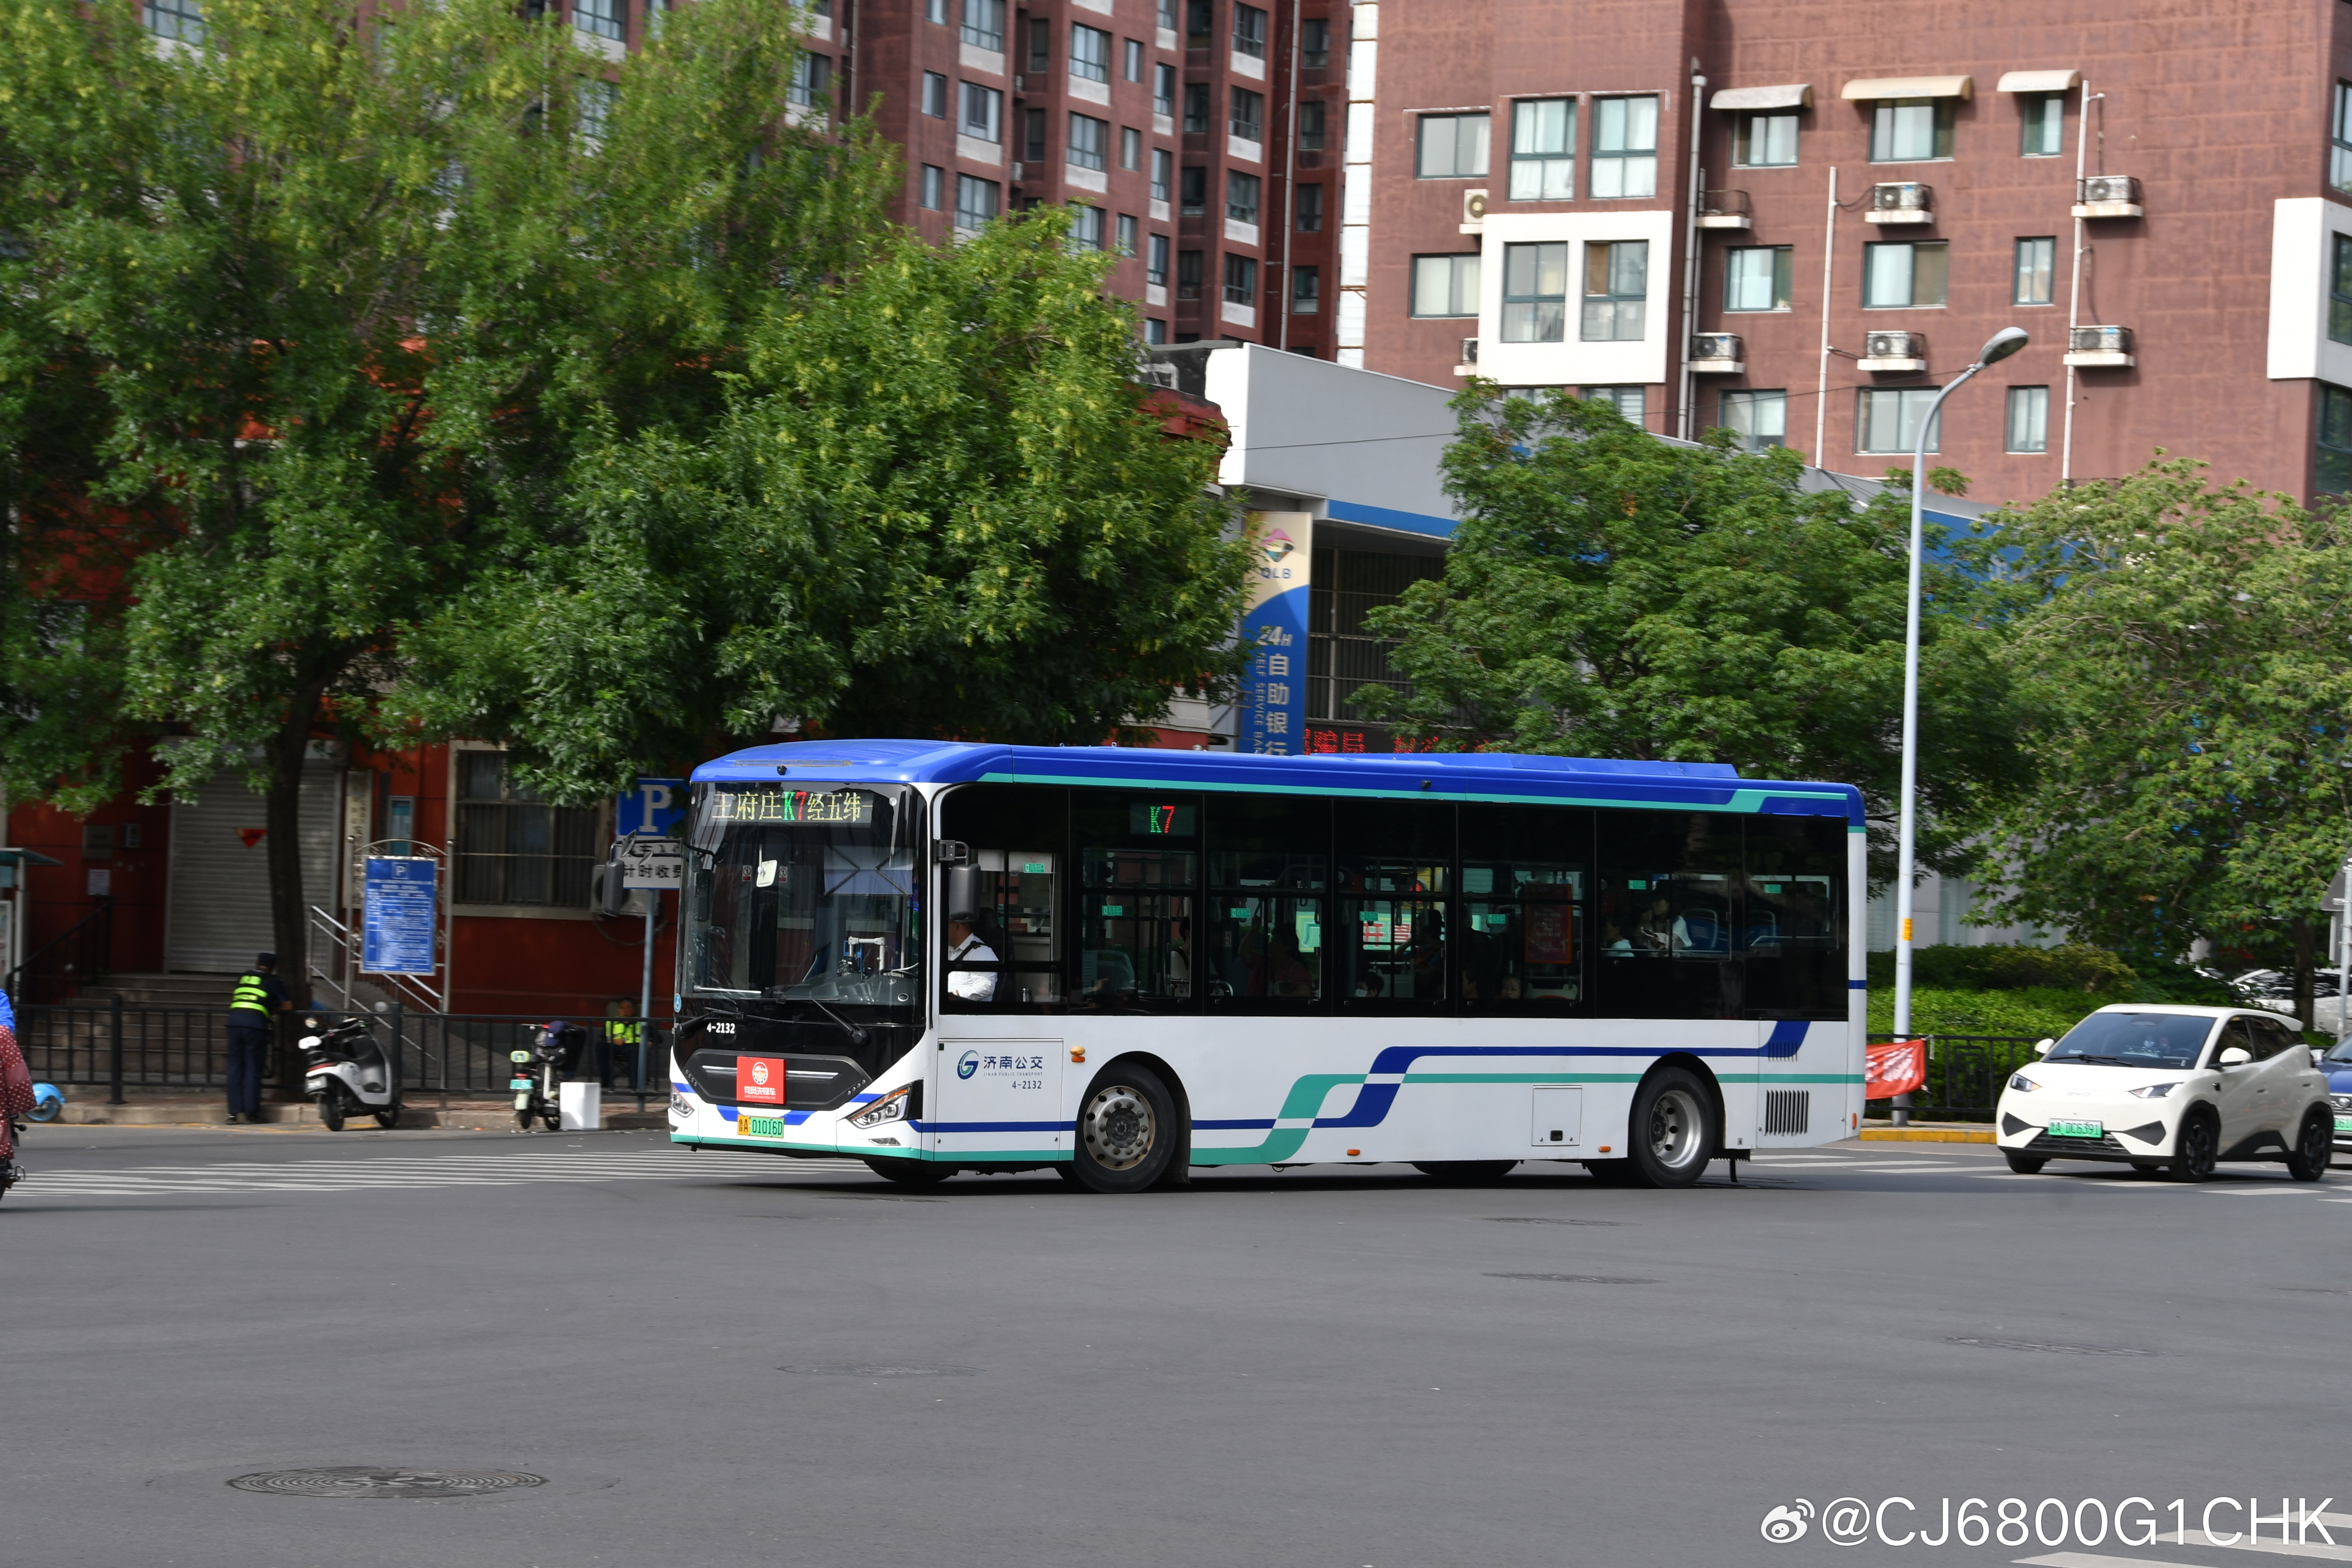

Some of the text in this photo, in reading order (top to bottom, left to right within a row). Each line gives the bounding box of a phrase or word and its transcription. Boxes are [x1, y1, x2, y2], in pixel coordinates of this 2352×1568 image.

[1254, 683, 1266, 726] SERVICE
[639, 784, 673, 833] P
[1150, 805, 1175, 834] K7
[706, 1022, 735, 1034] 4-2132
[983, 1056, 1043, 1070] 济南公交
[744, 1086, 776, 1096] 党员先锋车
[1012, 1080, 1042, 1089] 4-2132
